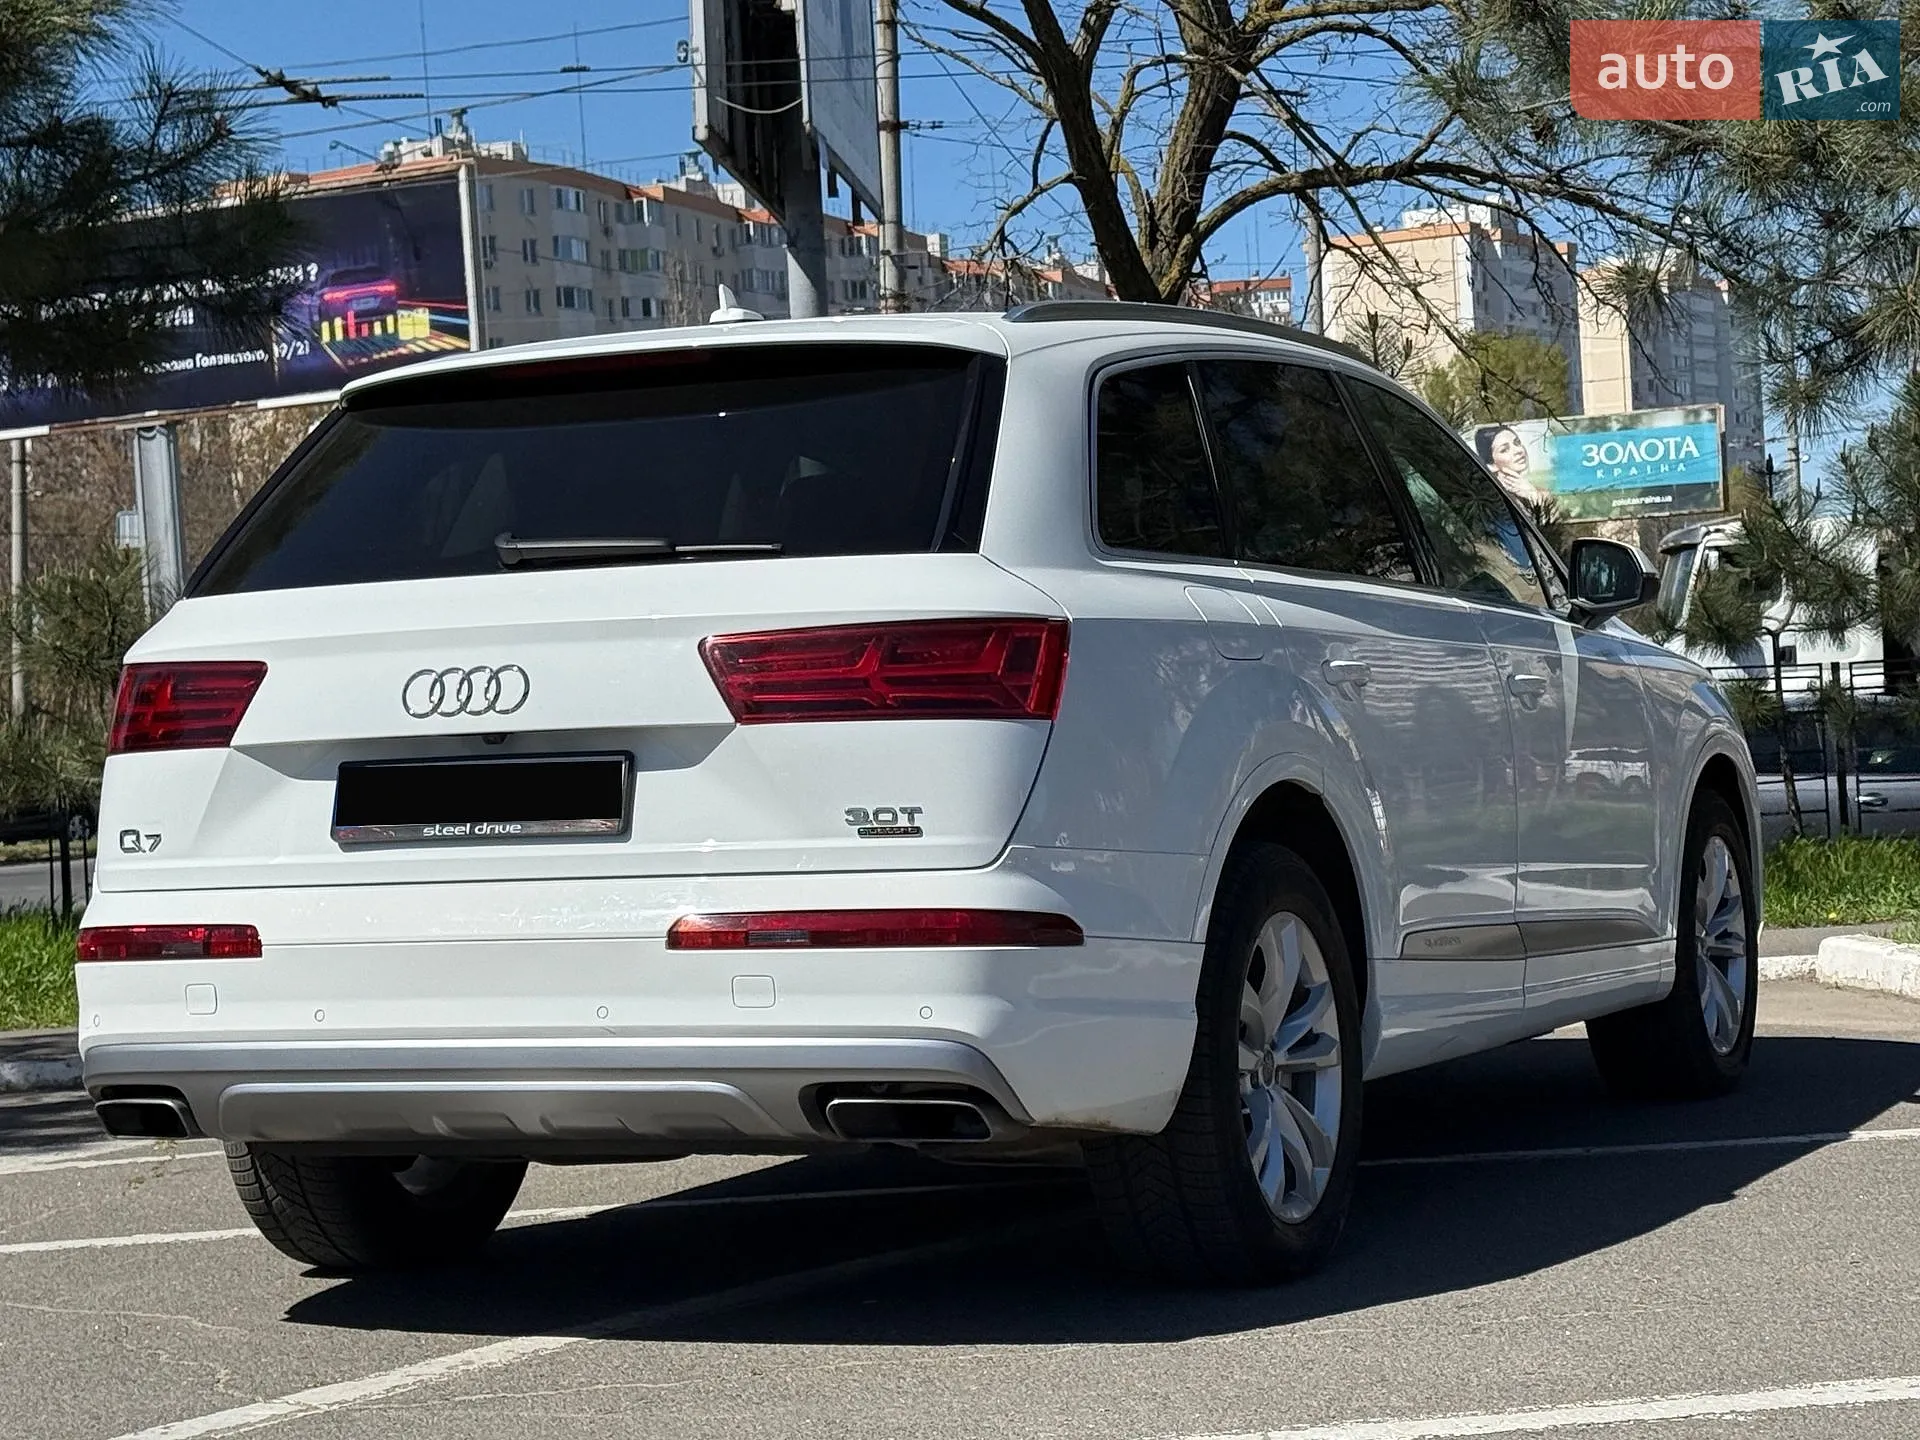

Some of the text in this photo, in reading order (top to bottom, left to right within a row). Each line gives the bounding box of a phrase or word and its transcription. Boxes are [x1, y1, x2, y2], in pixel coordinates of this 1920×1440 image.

[1581, 435, 1700, 467] ЗОЛОТА
[119, 829, 162, 853] Q7
[423, 821, 522, 837] steel drive
